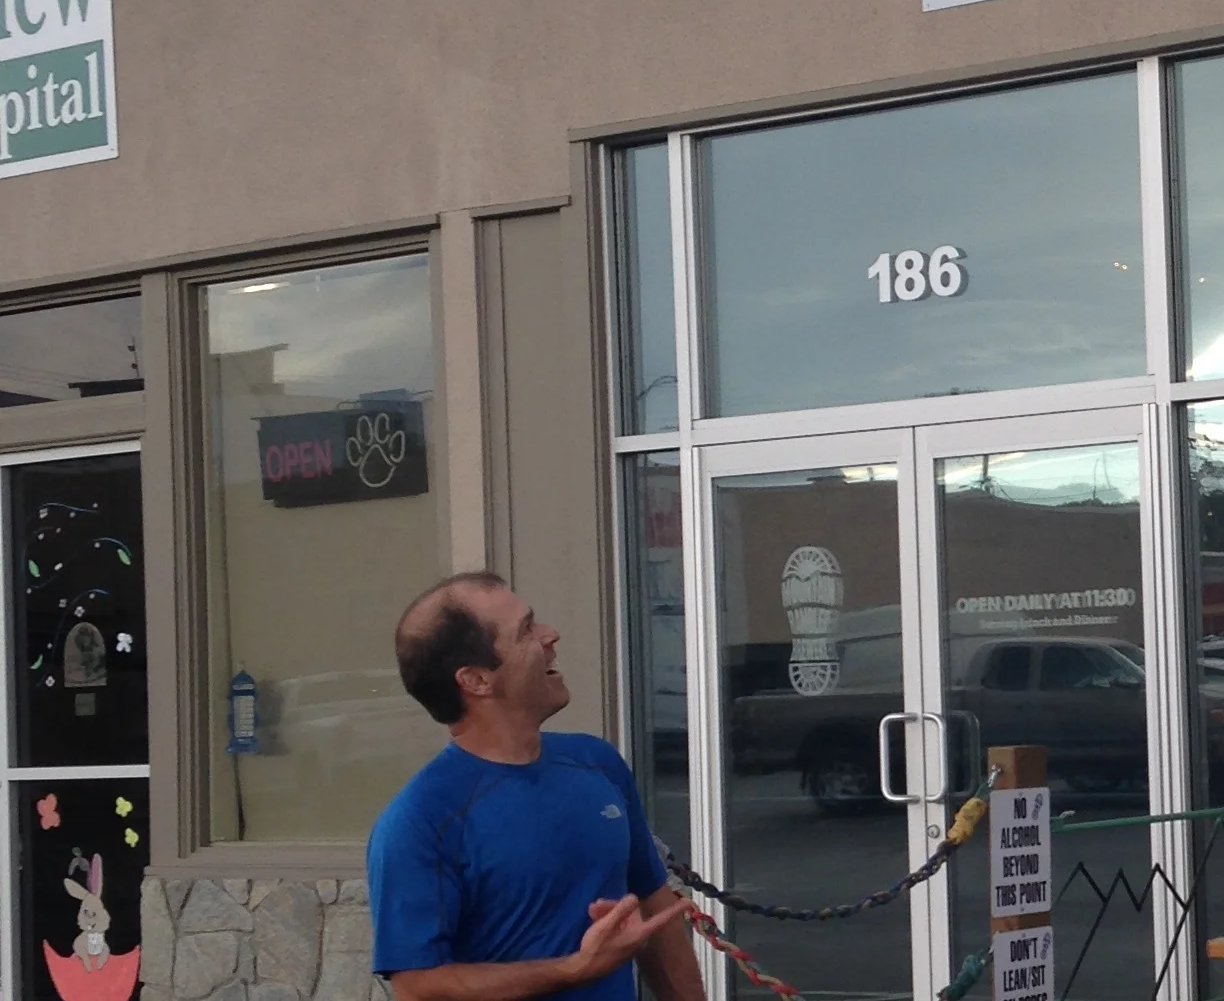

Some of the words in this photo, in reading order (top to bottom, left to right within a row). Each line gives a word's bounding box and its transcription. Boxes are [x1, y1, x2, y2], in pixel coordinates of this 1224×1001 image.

[868, 245, 962, 303] 186
[266, 439, 333, 482] OPEN
[956, 596, 1000, 613] OPEN
[1003, 593, 1055, 611] DAILY
[1060, 592, 1081, 608] AT
[1014, 797, 1026, 819] NO
[1000, 825, 1041, 849] ALCOHOL
[1003, 854, 1039, 878] BEYOND
[995, 884, 1017, 907] THIS
[1020, 881, 1046, 904] POINT
[1010, 938, 1037, 962] DON'T
[1003, 965, 1045, 992] LEAN/SIT
